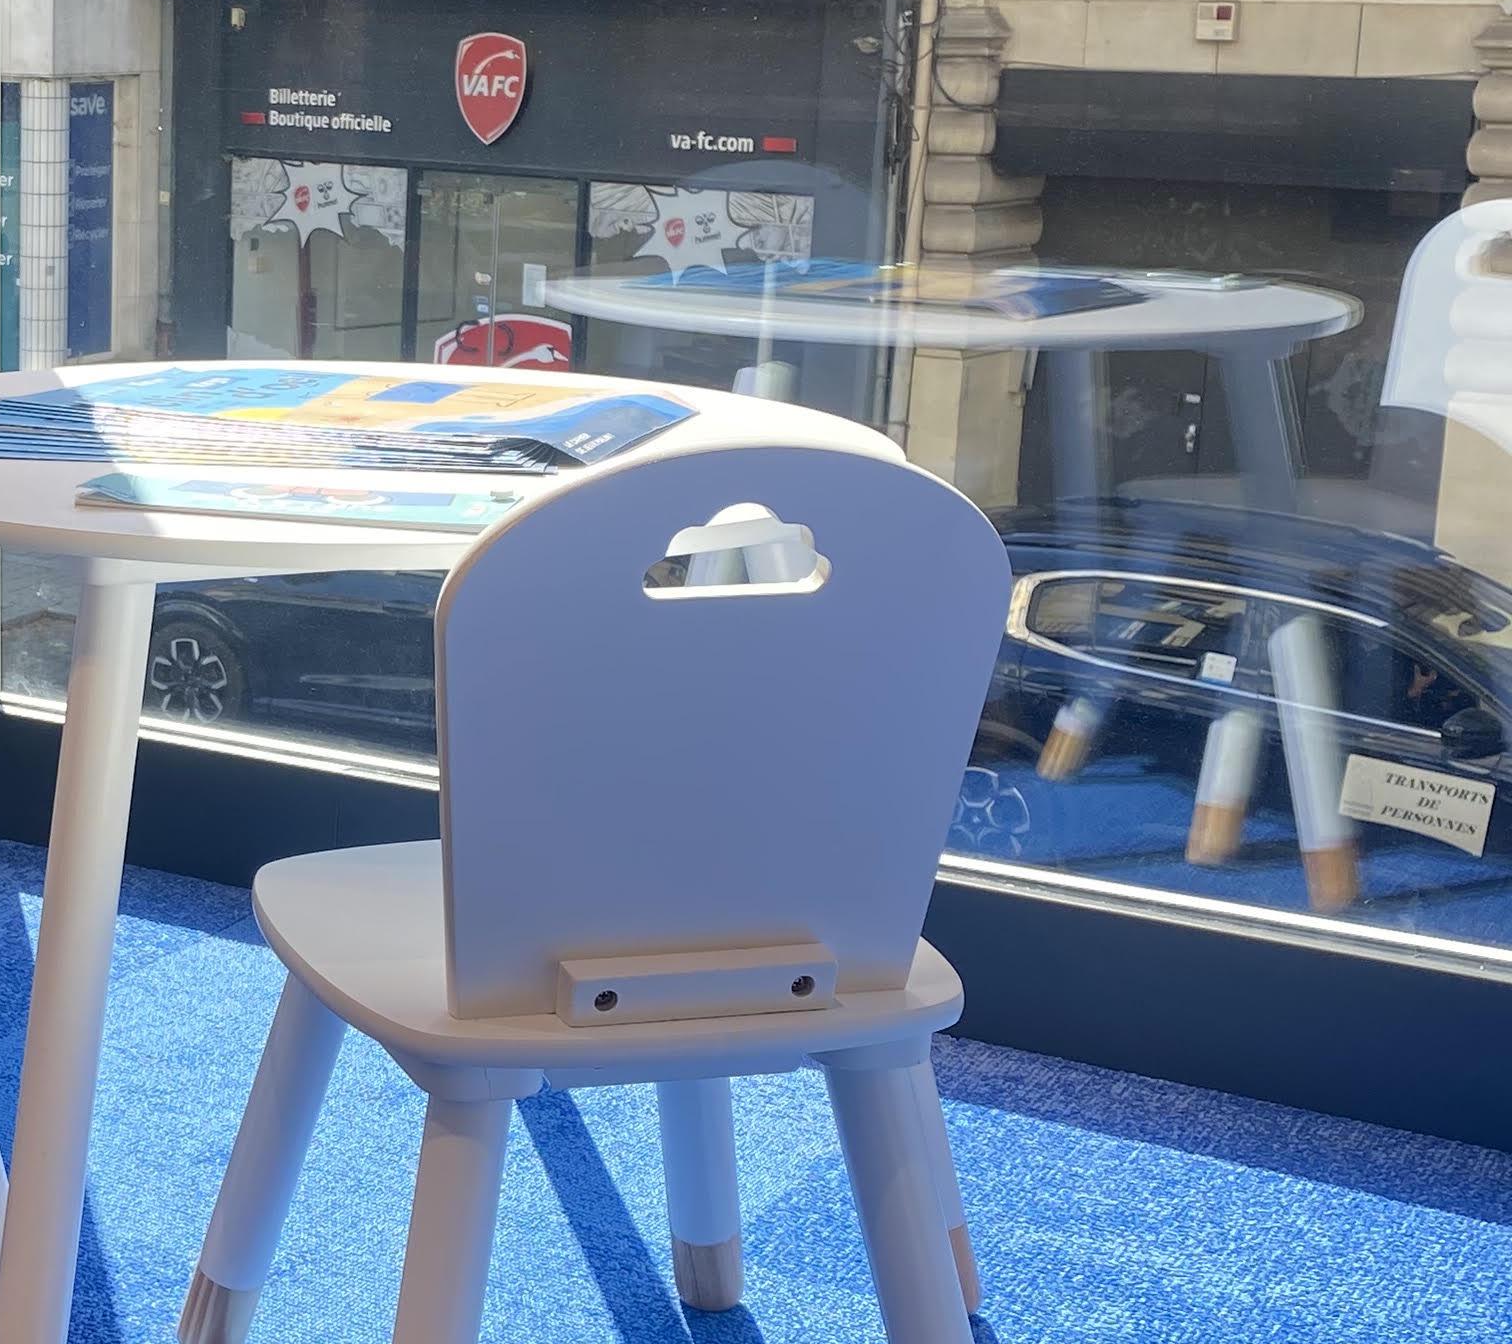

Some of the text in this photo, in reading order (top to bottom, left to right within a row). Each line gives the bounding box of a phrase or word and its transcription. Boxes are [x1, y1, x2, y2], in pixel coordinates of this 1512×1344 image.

[269, 88, 337, 107] Billetterie
[462, 74, 520, 98] VAFC
[269, 110, 392, 133] Boutique officielle
[670, 131, 754, 153] va-fc.com
[1385, 772, 1489, 805] TRANSPORTS
[1417, 796, 1442, 811] DE
[1379, 805, 1478, 836] PERSONNES
